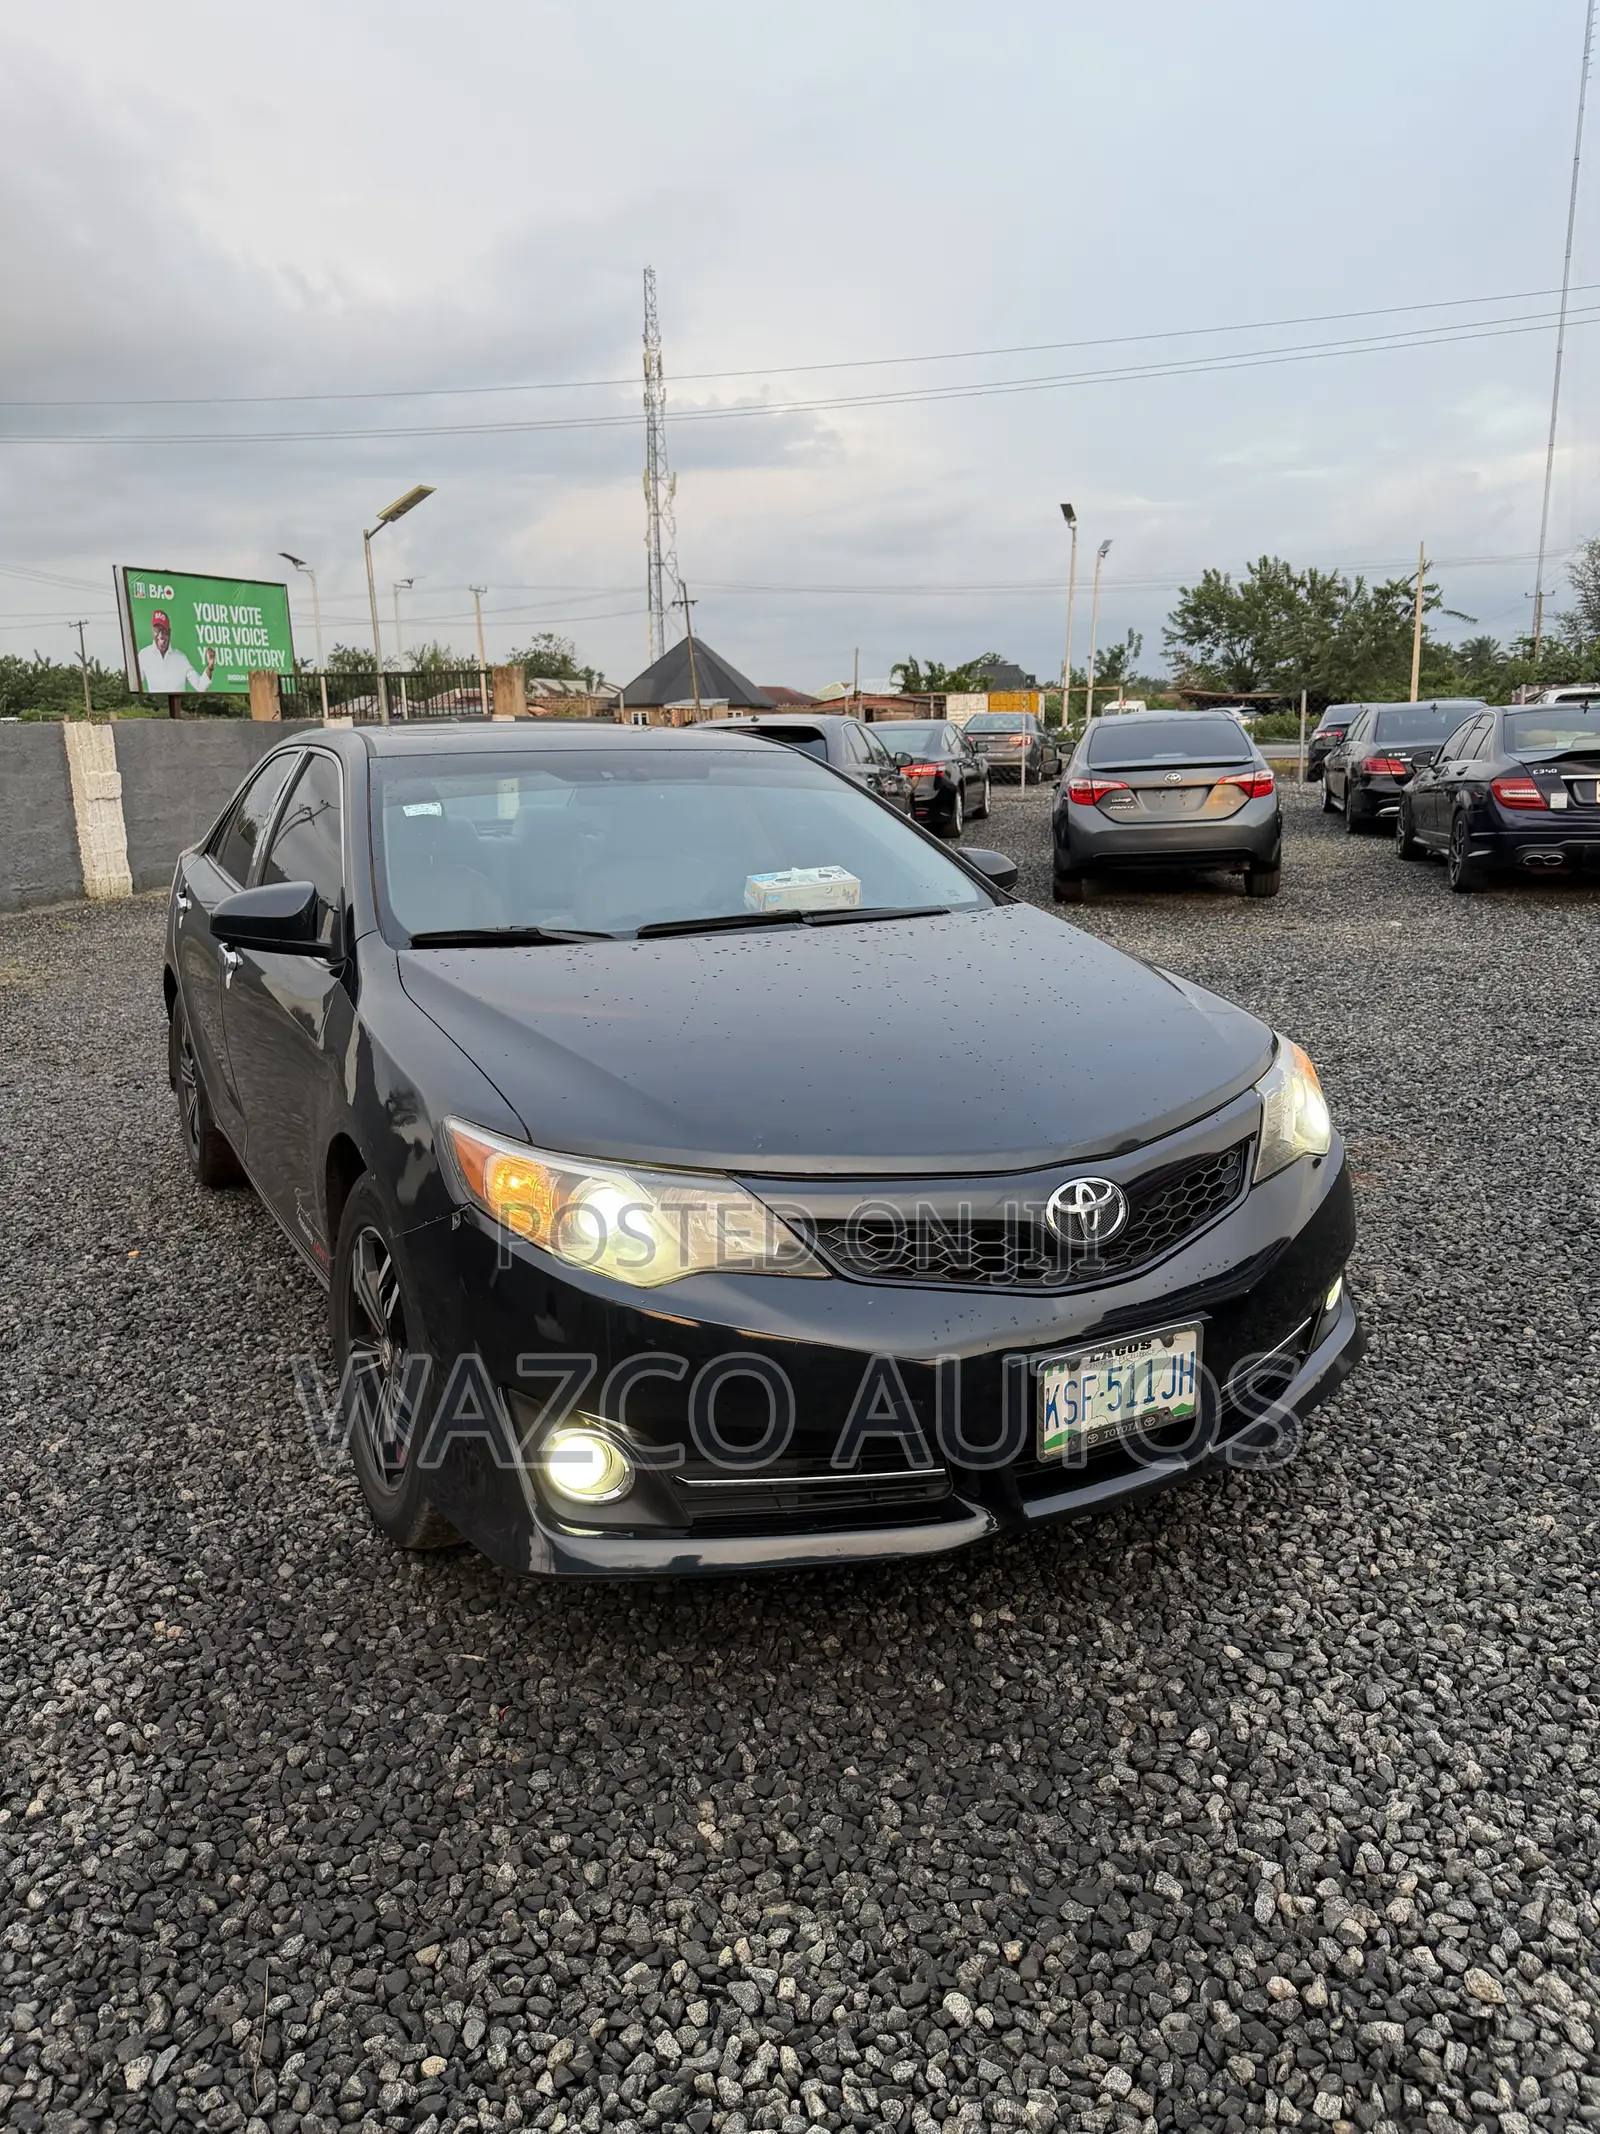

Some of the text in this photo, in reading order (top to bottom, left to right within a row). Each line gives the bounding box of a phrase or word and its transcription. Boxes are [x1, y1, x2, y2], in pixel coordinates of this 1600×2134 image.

[149, 584, 175, 601] BAO
[193, 602, 263, 626] YOUR VOTE
[195, 624, 269, 647] YOUR VOICE
[197, 646, 286, 668] YUR VICTORY
[1089, 1340, 1152, 1363] LAGOS
[1103, 1421, 1140, 1439] TOYOTA
